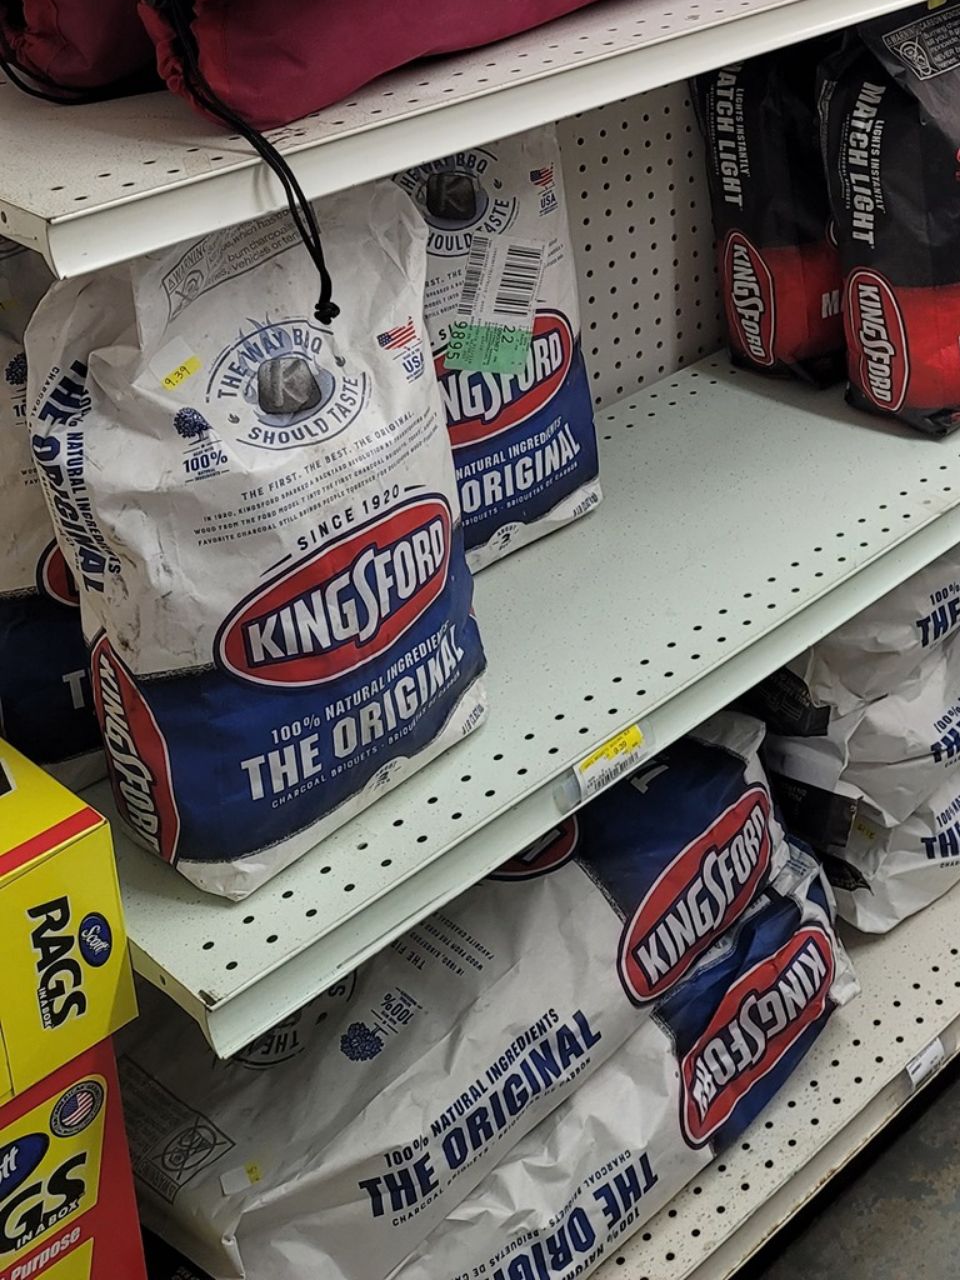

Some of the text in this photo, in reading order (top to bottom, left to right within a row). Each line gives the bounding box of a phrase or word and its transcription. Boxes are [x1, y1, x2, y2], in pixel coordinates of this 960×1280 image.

[735, 87, 750, 176] LIGHTS INSTANTLY
[848, 81, 887, 245] MATCH LIGHT
[540, 193, 557, 209] USA
[717, 139, 743, 208] LIGHT
[869, 120, 885, 214] LIGHTS INSTANTLY
[501, 324, 517, 344] 22
[732, 244, 766, 358] KINGSFORD
[446, 321, 468, 361] 9895
[858, 284, 896, 403] KINGSFORD
[164, 365, 190, 388] 9.39
[247, 375, 360, 446] SHOULD TASTE
[182, 449, 229, 473] 100%
[241, 486, 265, 502] THE
[268, 472, 303, 494] FIRST.
[304, 460, 323, 475] THE
[325, 448, 353, 467] BEST.
[354, 435, 374, 451] THE
[455, 450, 505, 482] NATURAL
[461, 423, 581, 514] ORIGINAL
[297, 484, 401, 552] SINCE 1920
[247, 519, 445, 663] KINGSFORD
[930, 581, 960, 606] 100%
[240, 624, 465, 801] THE ORIGINAL
[271, 714, 321, 745] 100%
[324, 677, 386, 719] NATURAL
[637, 804, 767, 986] KINGSFORD
[27, 895, 88, 1027] RAGS
[81, 923, 110, 957] Scott
[383, 992, 417, 1026] 100%
[359, 1009, 603, 1219] THE ORIGINAL
[383, 1007, 560, 1169] 100% NATURAL INGREDIENTS
[583, 1149, 632, 1188] CHARCOAL
[10, 1225, 82, 1280] Purpose
[16, 1198, 81, 1252] IN A BOX
[488, 1229, 540, 1268] BRIQUETAS
